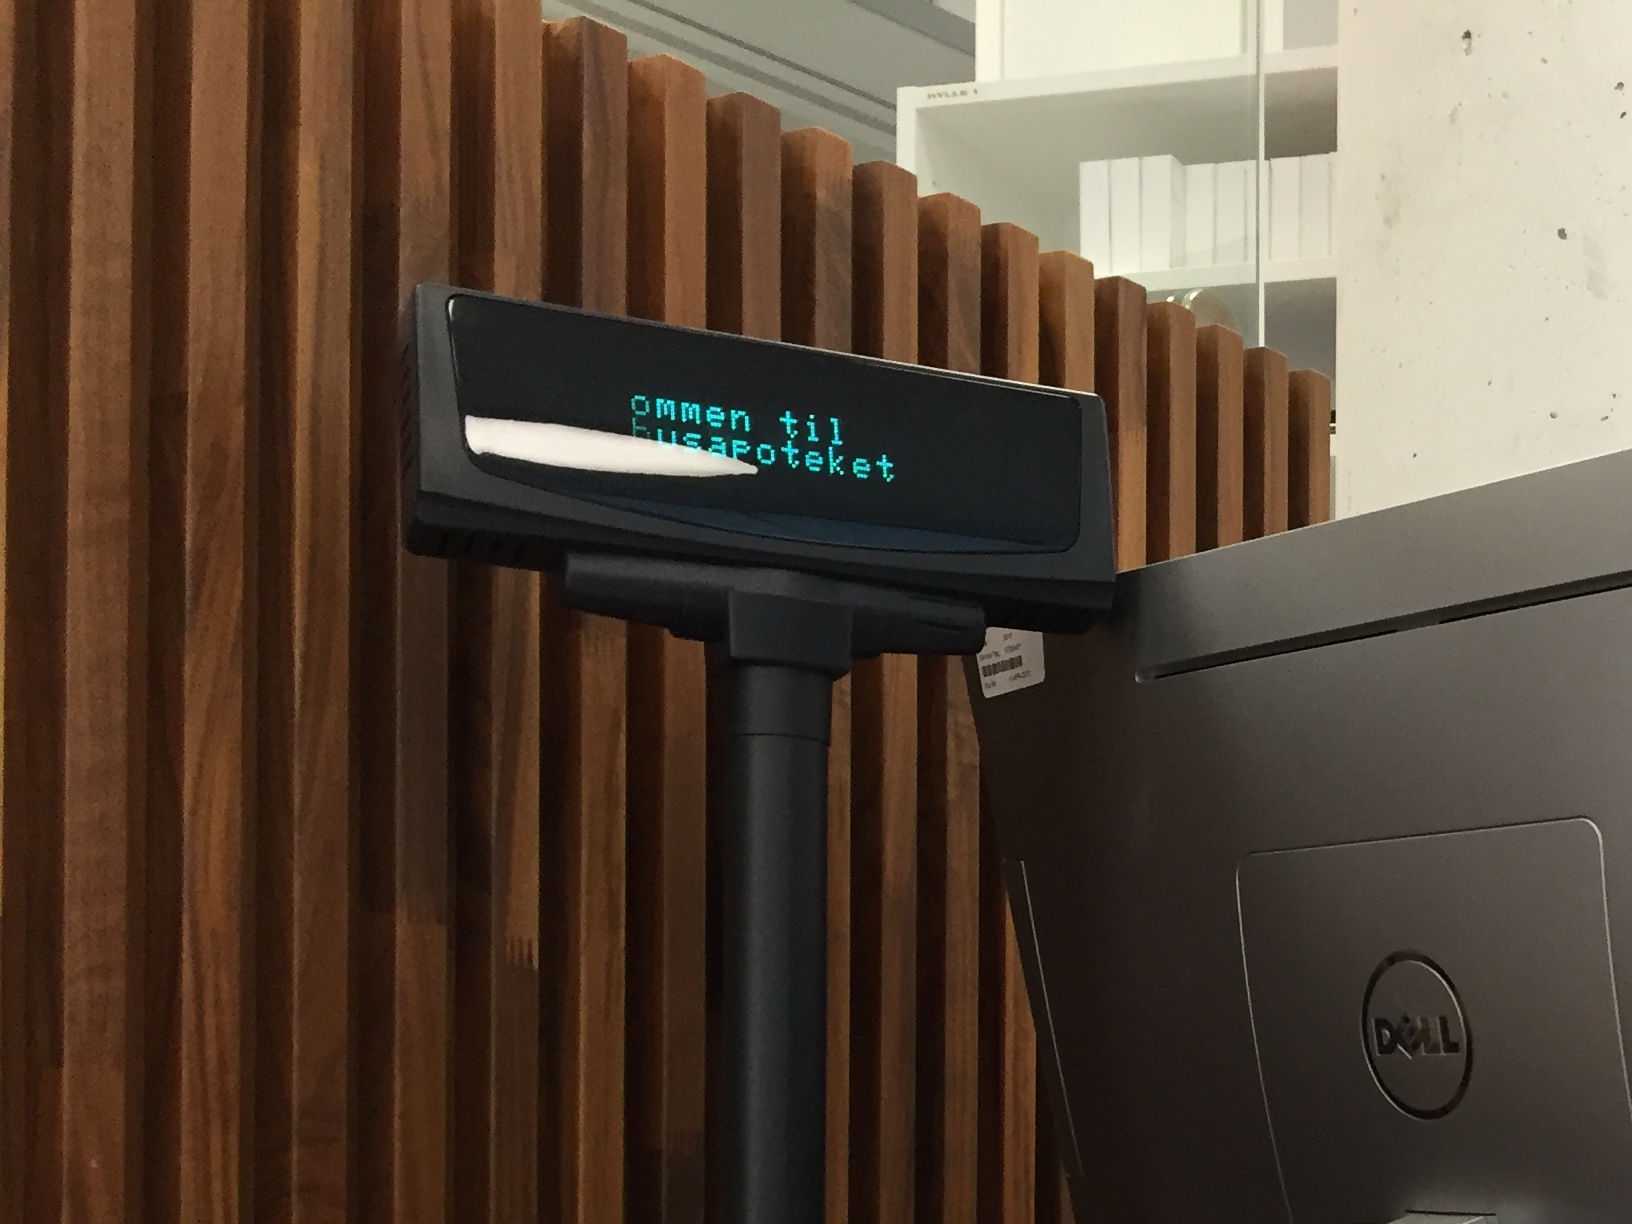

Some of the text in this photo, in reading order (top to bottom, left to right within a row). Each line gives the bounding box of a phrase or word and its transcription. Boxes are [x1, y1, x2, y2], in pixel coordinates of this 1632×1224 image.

[631, 395, 843, 445] ommen til
[1373, 1015, 1460, 1055] DELL
